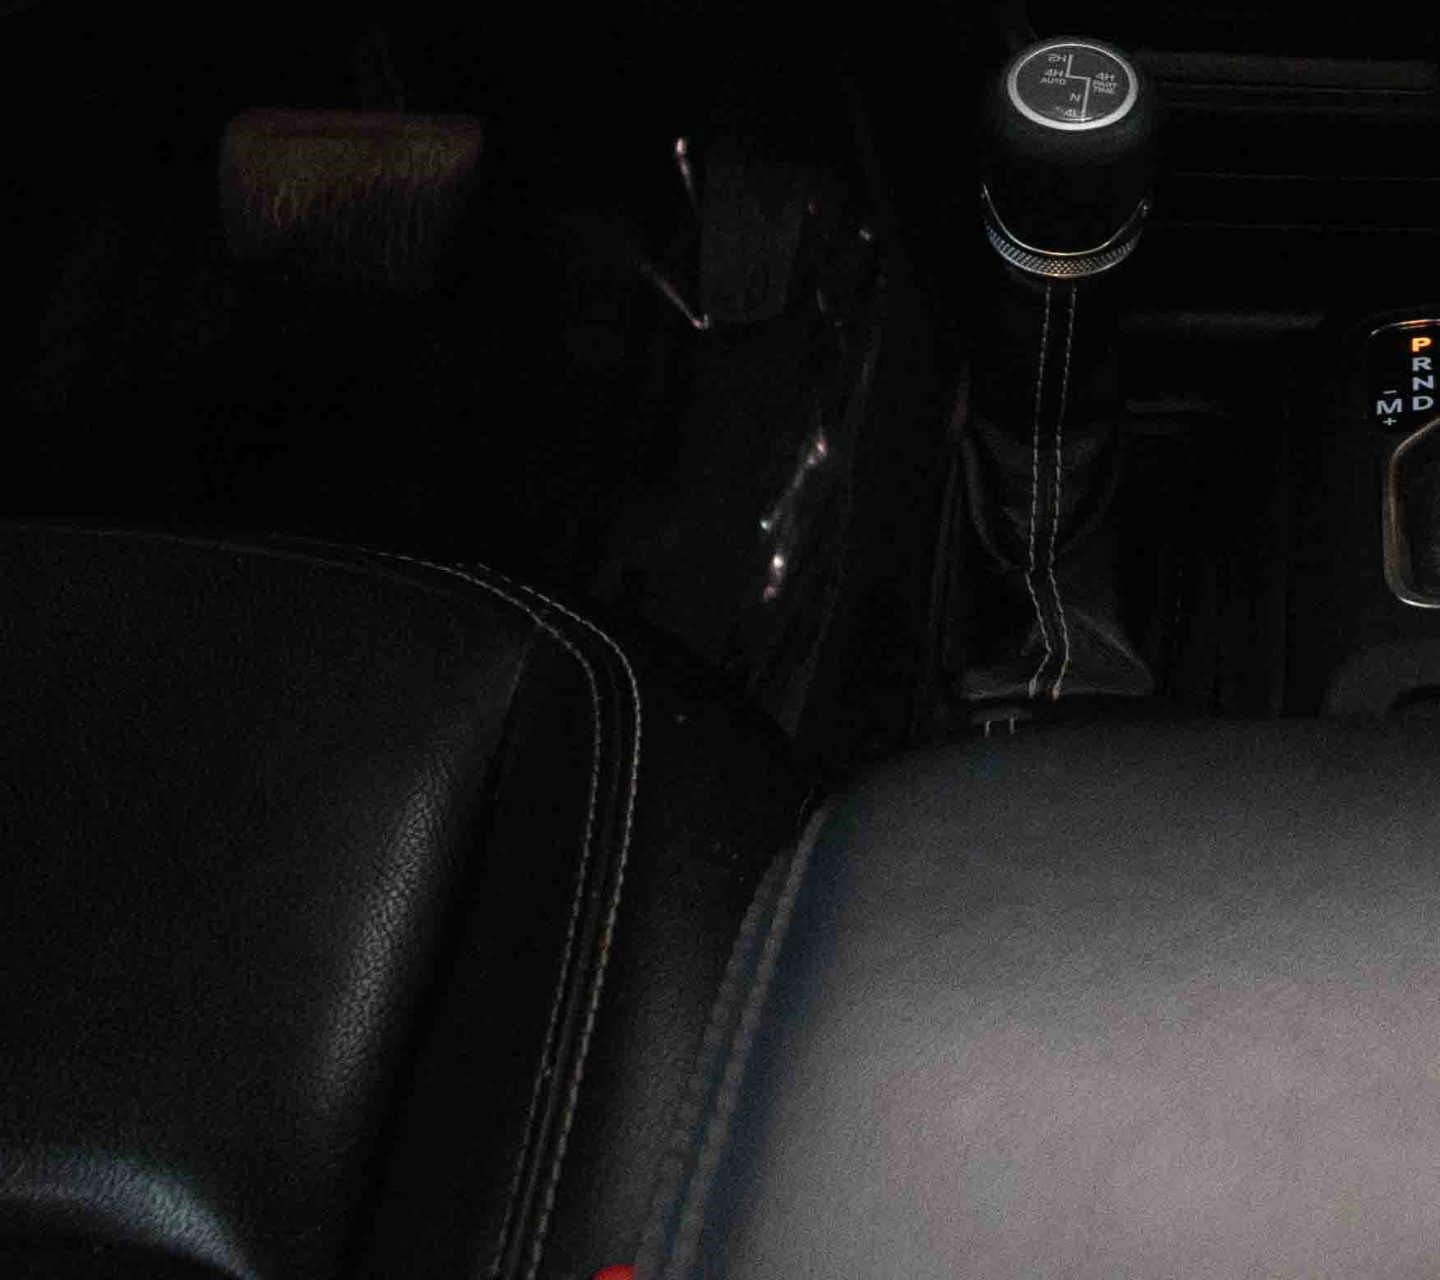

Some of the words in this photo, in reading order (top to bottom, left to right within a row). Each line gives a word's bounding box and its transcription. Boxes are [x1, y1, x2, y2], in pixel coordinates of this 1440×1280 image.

[1411, 336, 1432, 353] P
[1412, 356, 1433, 372] R
[1413, 375, 1434, 390] N
[1377, 399, 1402, 414] M
[1413, 396, 1433, 410] D
